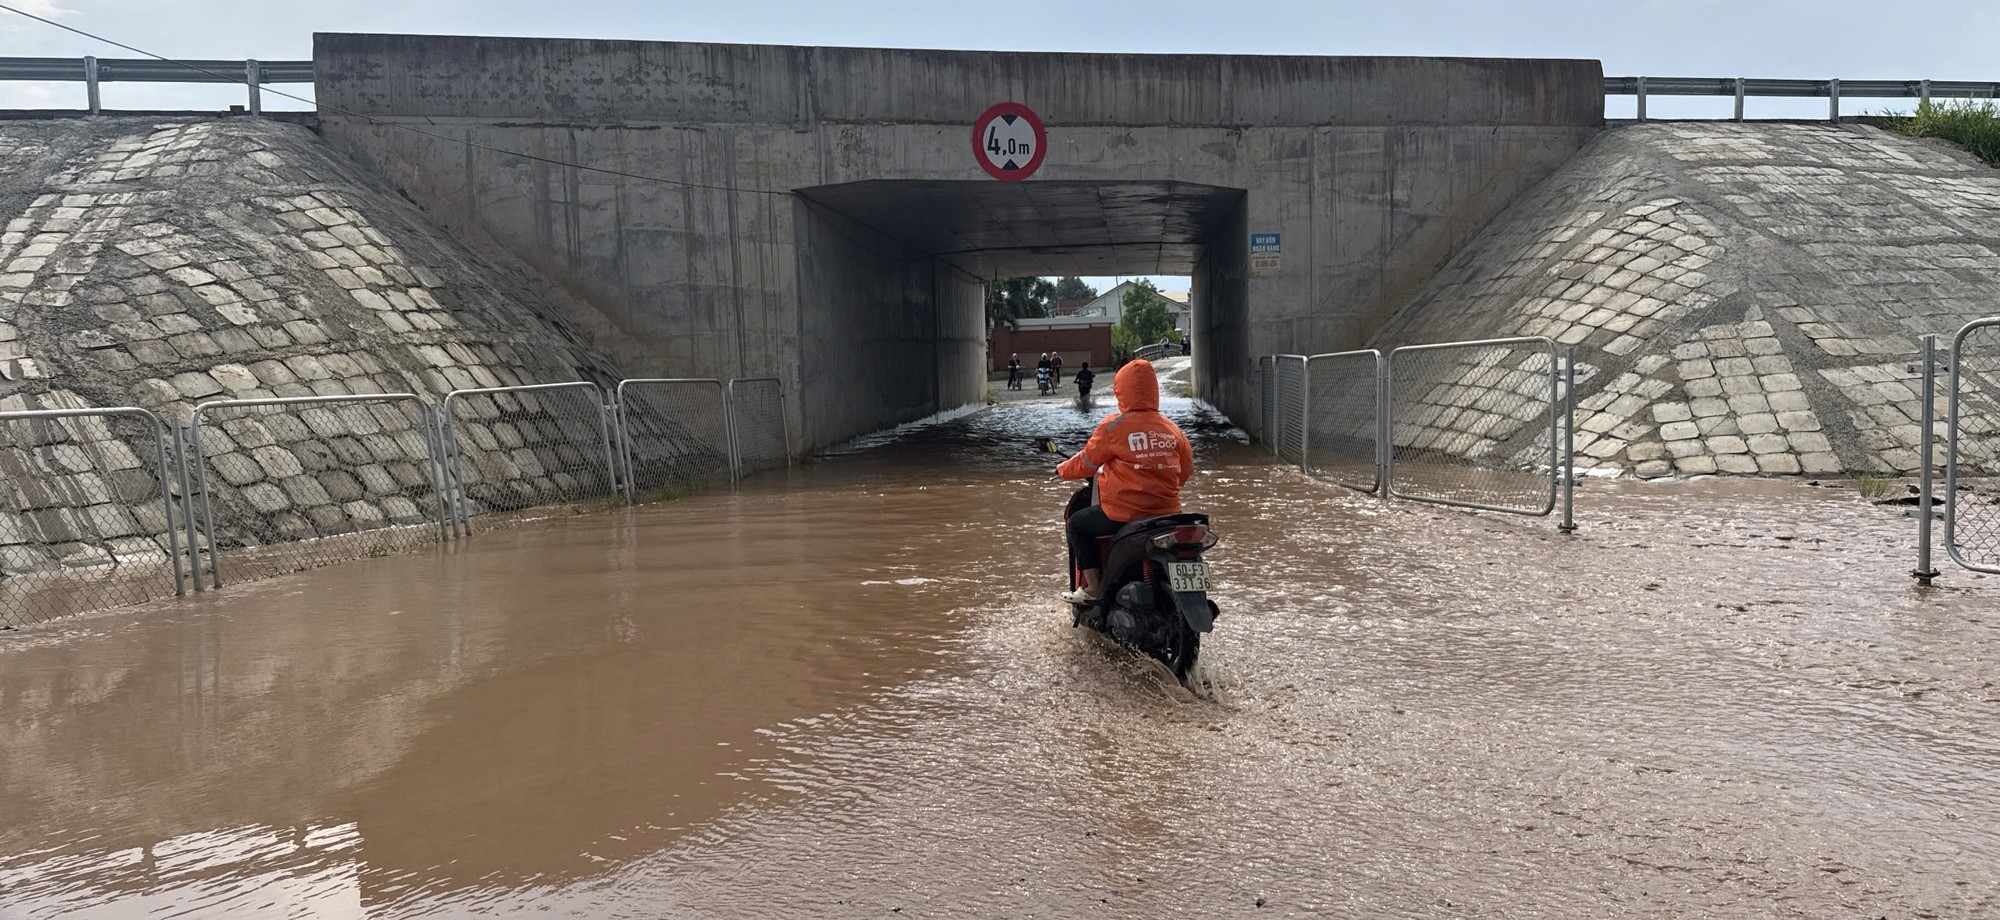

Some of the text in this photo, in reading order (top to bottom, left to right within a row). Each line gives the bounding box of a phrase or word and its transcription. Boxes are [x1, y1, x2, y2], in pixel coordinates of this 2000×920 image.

[1149, 430, 1176, 440] Shopee
[1150, 438, 1177, 449] Food
[1174, 577, 1211, 590] 331.36
